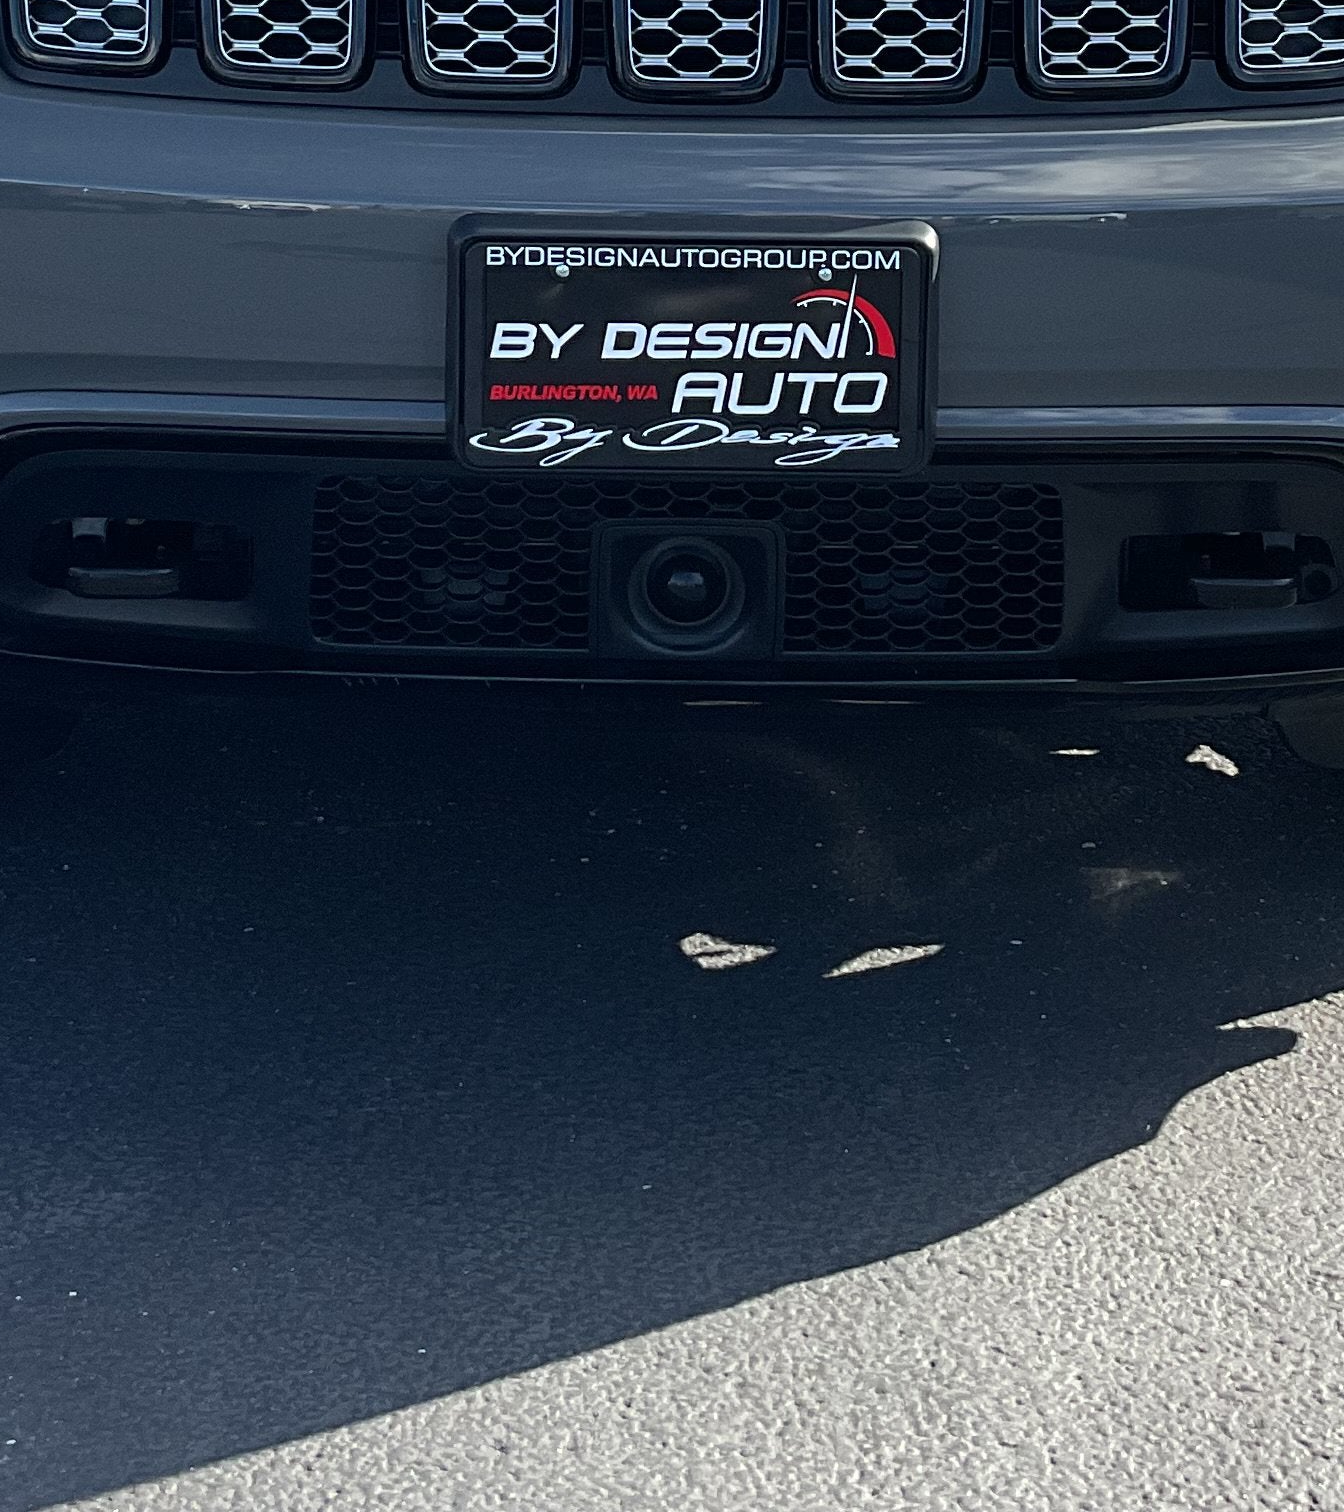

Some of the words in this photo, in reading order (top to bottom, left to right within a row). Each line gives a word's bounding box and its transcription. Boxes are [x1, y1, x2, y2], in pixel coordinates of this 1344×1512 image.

[486, 246, 900, 270] BYDESIGNAUTOGROUP.COM
[489, 322, 585, 359] BY
[601, 322, 842, 359] DESIGN
[489, 385, 622, 403] BURLINGTON,
[627, 385, 659, 400] WA
[671, 372, 888, 414] AUTO
[469, 419, 614, 467] By
[622, 419, 901, 466] Design
